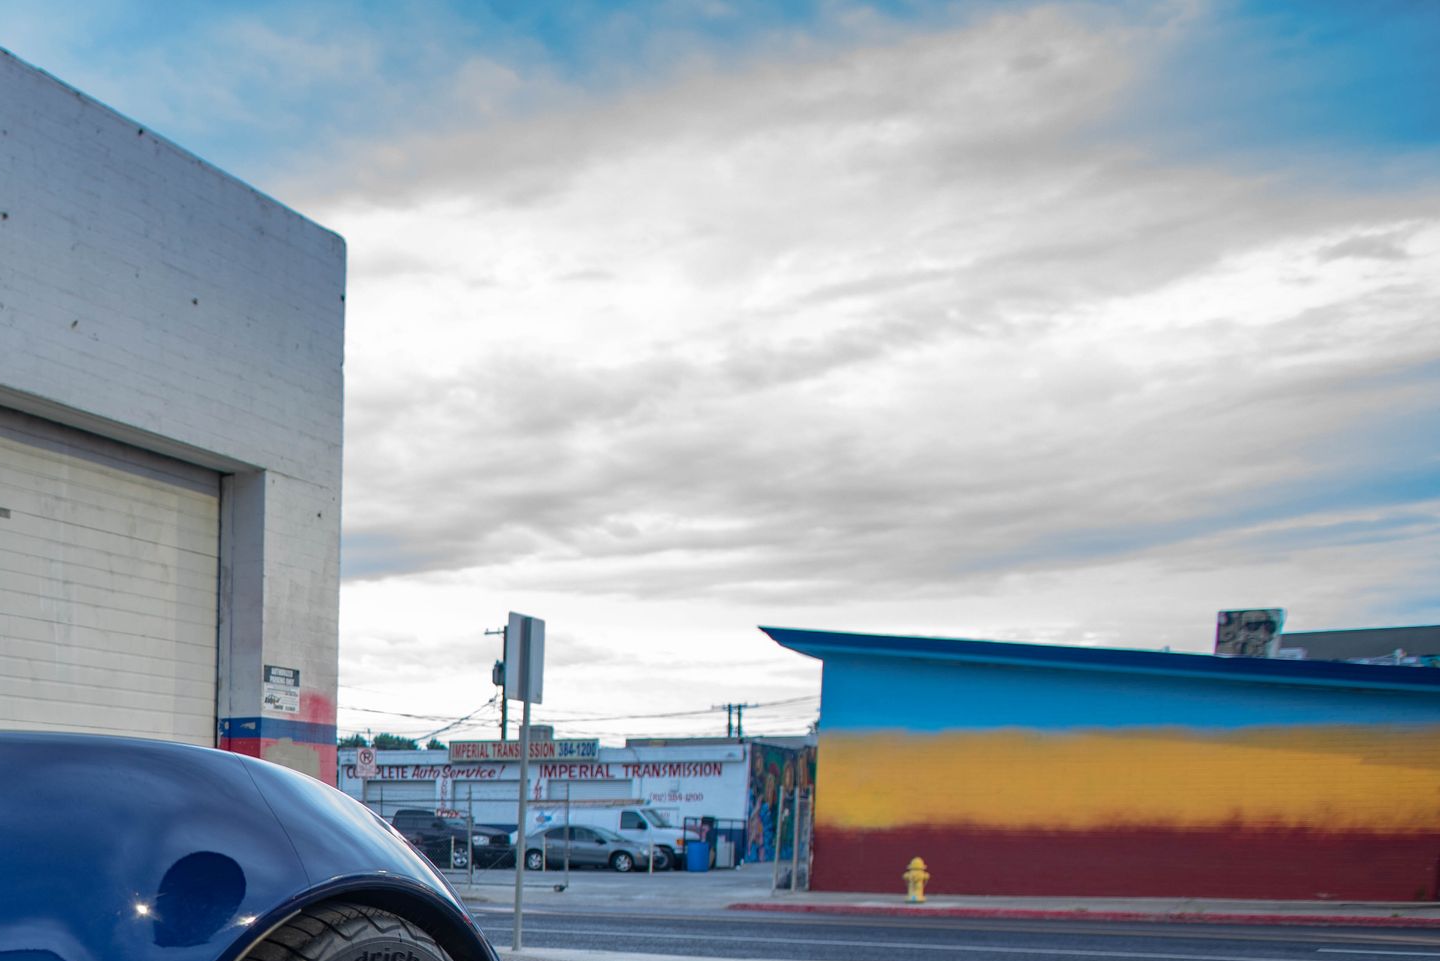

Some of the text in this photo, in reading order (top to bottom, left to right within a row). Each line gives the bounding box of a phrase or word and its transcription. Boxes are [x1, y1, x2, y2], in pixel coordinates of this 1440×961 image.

[452, 742, 489, 758] IMPERIAL
[492, 742, 555, 758] TRANSSSION
[346, 765, 408, 779] COPLETE
[412, 765, 440, 779] Auto
[539, 762, 723, 778] IMPERIAL TRANSMISSION
